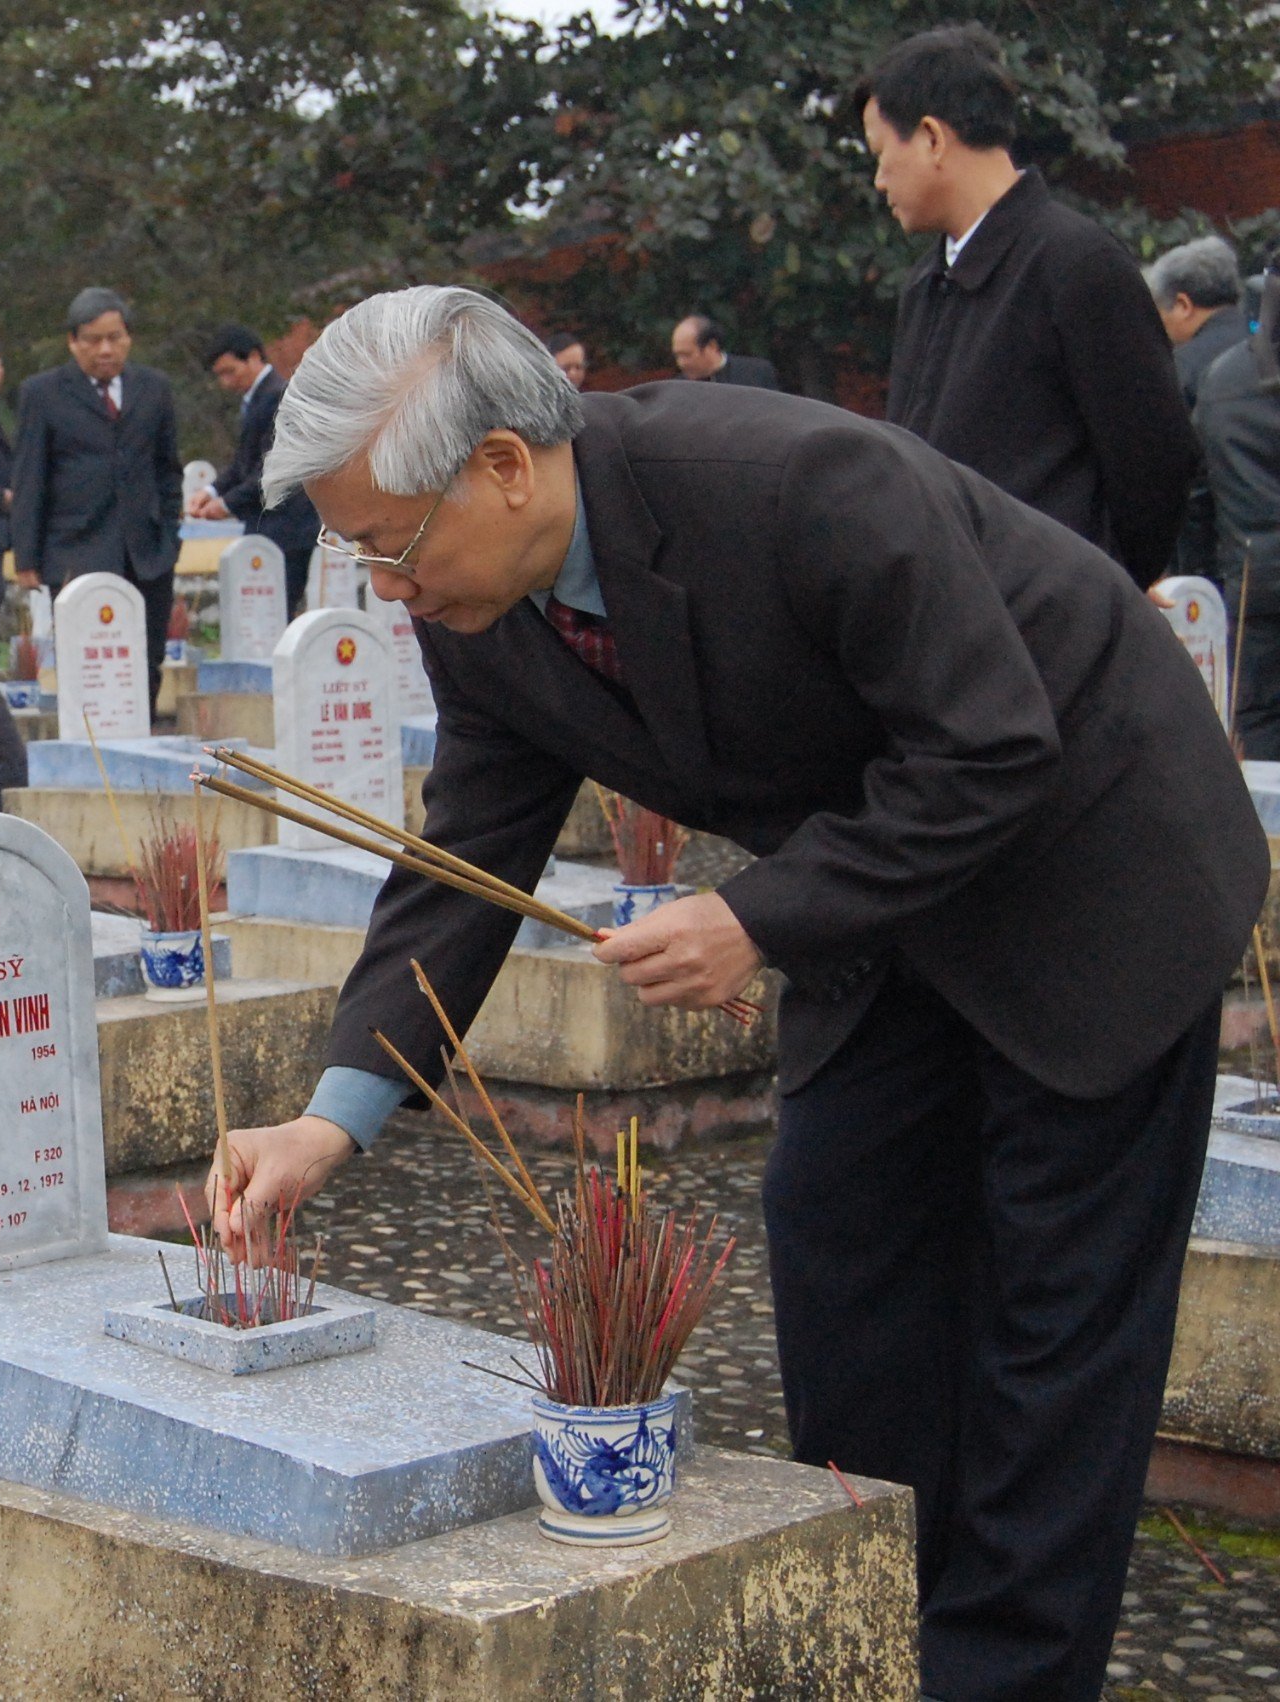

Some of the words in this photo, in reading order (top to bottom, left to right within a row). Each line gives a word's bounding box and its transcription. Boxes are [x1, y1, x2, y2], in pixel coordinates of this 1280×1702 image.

[13, 993, 50, 1035] VINH
[31, 1044, 56, 1061] 1954
[40, 1091, 60, 1113] NỘI
[34, 1150, 41, 1163] F
[43, 1146, 63, 1161] 320
[8, 1211, 28, 1227] 107
